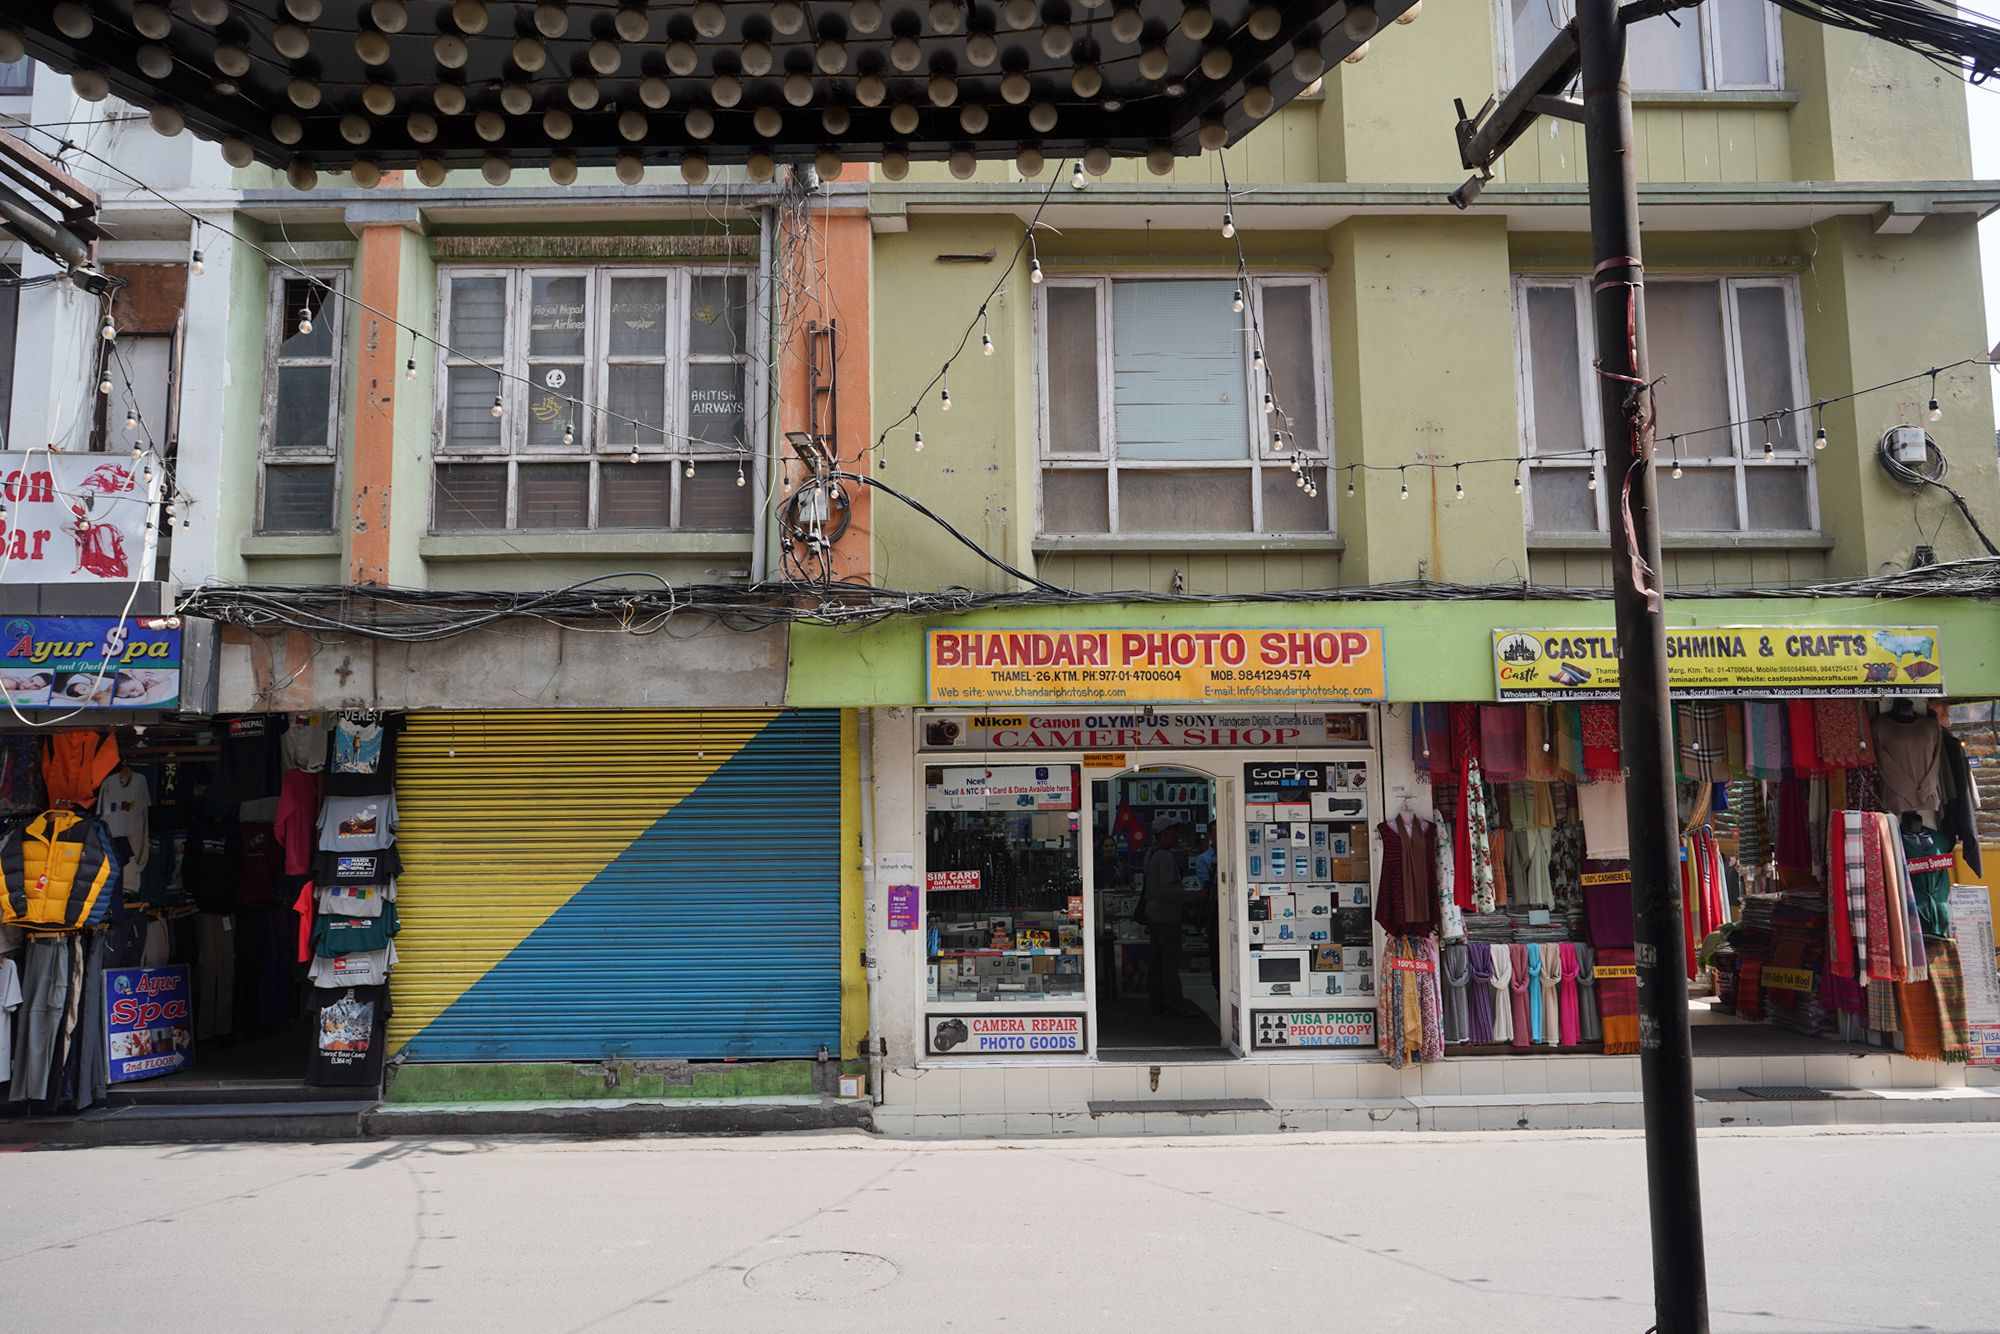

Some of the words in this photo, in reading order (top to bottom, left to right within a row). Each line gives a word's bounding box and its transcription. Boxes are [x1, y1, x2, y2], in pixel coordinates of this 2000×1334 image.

[533, 304, 558, 315] Royal
[559, 303, 584, 318] Nepal
[552, 319, 586, 330] Airlines
[691, 390, 737, 401] BRITISH
[692, 401, 744, 414] AIRWAYS
[0, 469, 54, 503] on
[7, 635, 95, 663] Ayur
[101, 627, 170, 664] Spa
[936, 633, 1110, 668] BHANDARI
[1121, 632, 1248, 668] PHOTO
[1259, 632, 1371, 667] SHOP
[1667, 635, 1747, 658] SHMINA
[1758, 635, 1774, 657] &
[1786, 634, 1868, 657] CRAFTS
[56, 661, 76, 671] and
[1500, 667, 1539, 682] Castle
[1668, 676, 1729, 684] shminacrafts.com
[937, 687, 959, 697] Web
[962, 687, 985, 697] site:
[986, 686, 1126, 698] www.bhandariphotoshop.com
[1204, 685, 1236, 696] E-mail:
[1541, 690, 1560, 698] Retail
[1568, 690, 1595, 699] Factory
[1773, 687, 1801, 695] Yakwool
[338, 709, 385, 722] EVEREST
[974, 717, 1022, 727] Nikon
[1029, 716, 1081, 729] Canon
[1085, 715, 1169, 728] OLYMPUS
[1174, 715, 1219, 728] SONY
[1219, 715, 1250, 728] Handycam
[1274, 714, 1301, 726] Cameras
[1302, 715, 1308, 725] &
[1309, 714, 1324, 726] Lens
[240, 719, 264, 729] NEPAL
[992, 729, 1174, 748] CAMERA
[1183, 728, 1301, 746] SHOP
[1252, 768, 1318, 779] GoPro
[966, 777, 985, 785] Ncell
[944, 788, 959, 796] Ncell
[966, 787, 979, 796] NTC
[993, 786, 1007, 795] Card
[1008, 786, 1013, 794] &
[1014, 785, 1028, 793] Data
[1028, 784, 1056, 793] Available
[1928, 856, 1953, 868] Sweater
[927, 872, 946, 881] SIM
[949, 871, 979, 880] CARD
[1398, 959, 1415, 969] 100%
[1415, 961, 1429, 970] Silk
[136, 973, 182, 997] Ayur
[1794, 975, 1810, 986] Wool
[111, 998, 188, 1030] Spa
[1290, 1014, 1322, 1025] VISA
[1326, 1013, 1372, 1024] PHOTO
[973, 1018, 1025, 1032] CAMERA
[1031, 1018, 1078, 1031] REPAIR
[1290, 1025, 1334, 1036] PHOTO
[1338, 1025, 1372, 1035] COPY
[980, 1036, 1026, 1050] PHOTO
[1029, 1036, 1076, 1049] GOODS
[1299, 1036, 1322, 1046] SIM
[1326, 1035, 1360, 1045] CARD
[351, 1051, 367, 1060] Camp
[125, 1062, 143, 1072] 2nd
[145, 1056, 175, 1068] FLOOR
